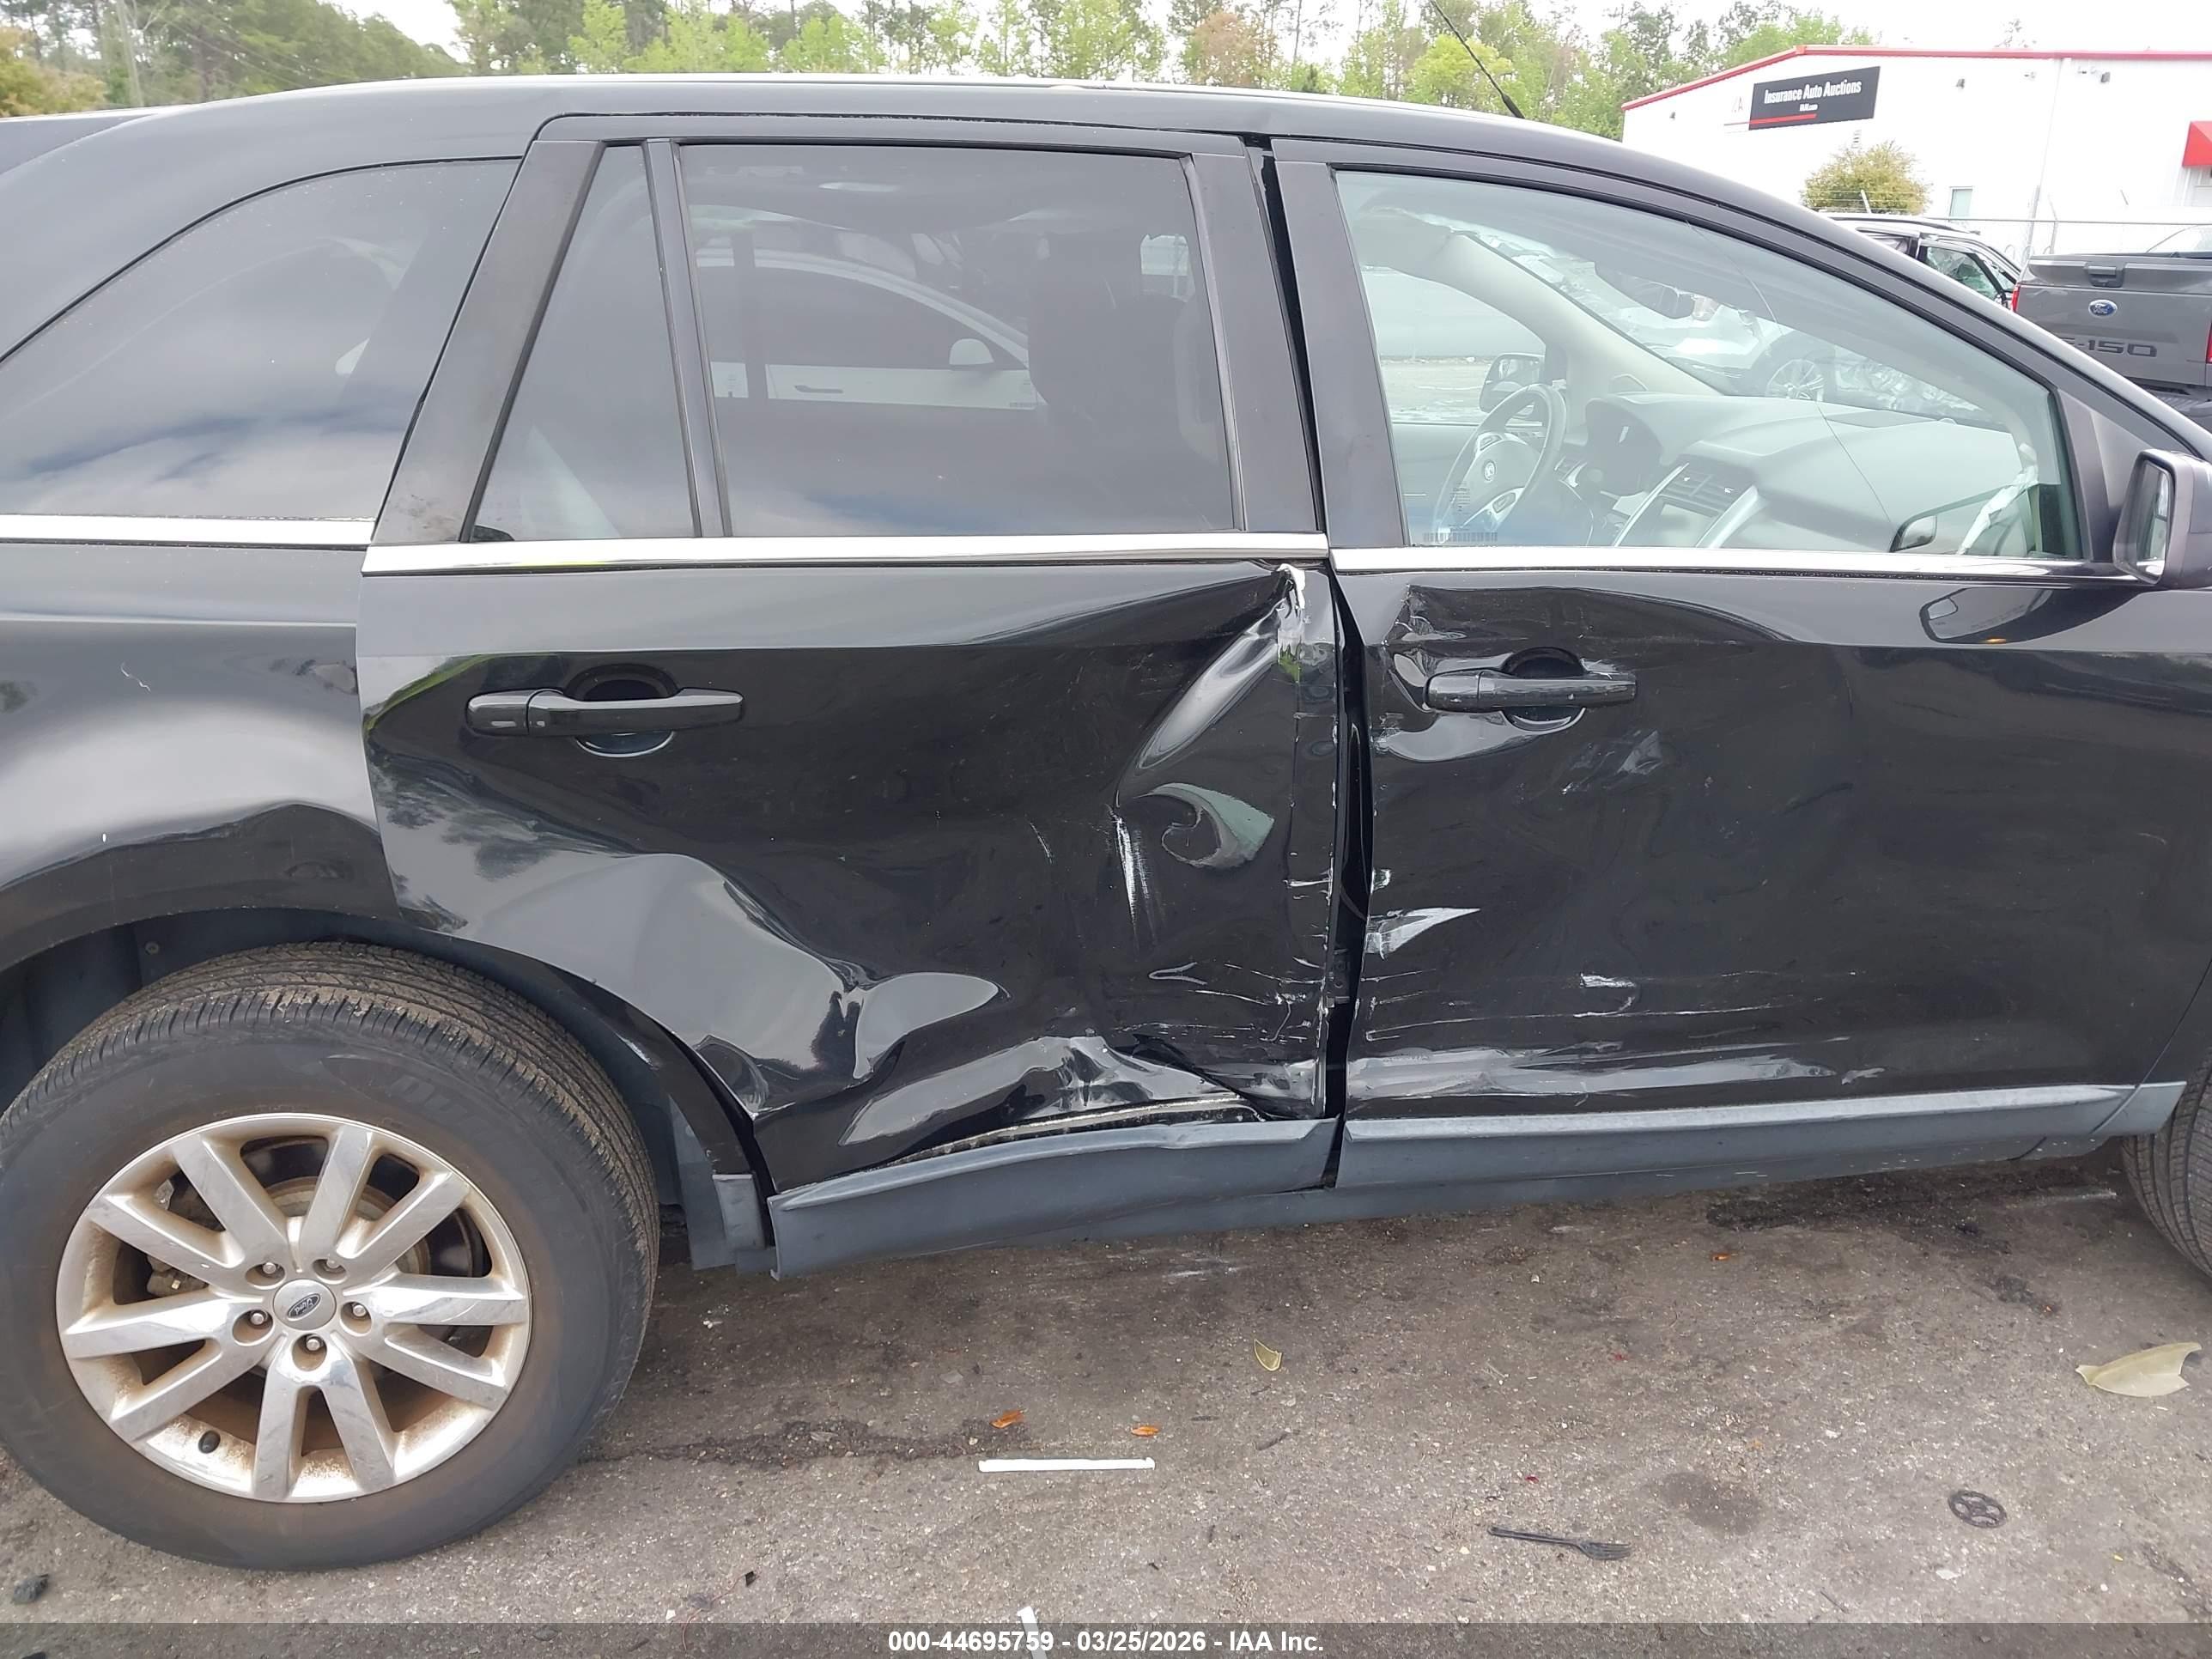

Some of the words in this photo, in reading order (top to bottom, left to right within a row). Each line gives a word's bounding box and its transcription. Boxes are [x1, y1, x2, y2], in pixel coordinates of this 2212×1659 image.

[1764, 89, 1802, 104] Insurance
[1802, 84, 1822, 100] Auto
[1823, 79, 1862, 97] Auctions
